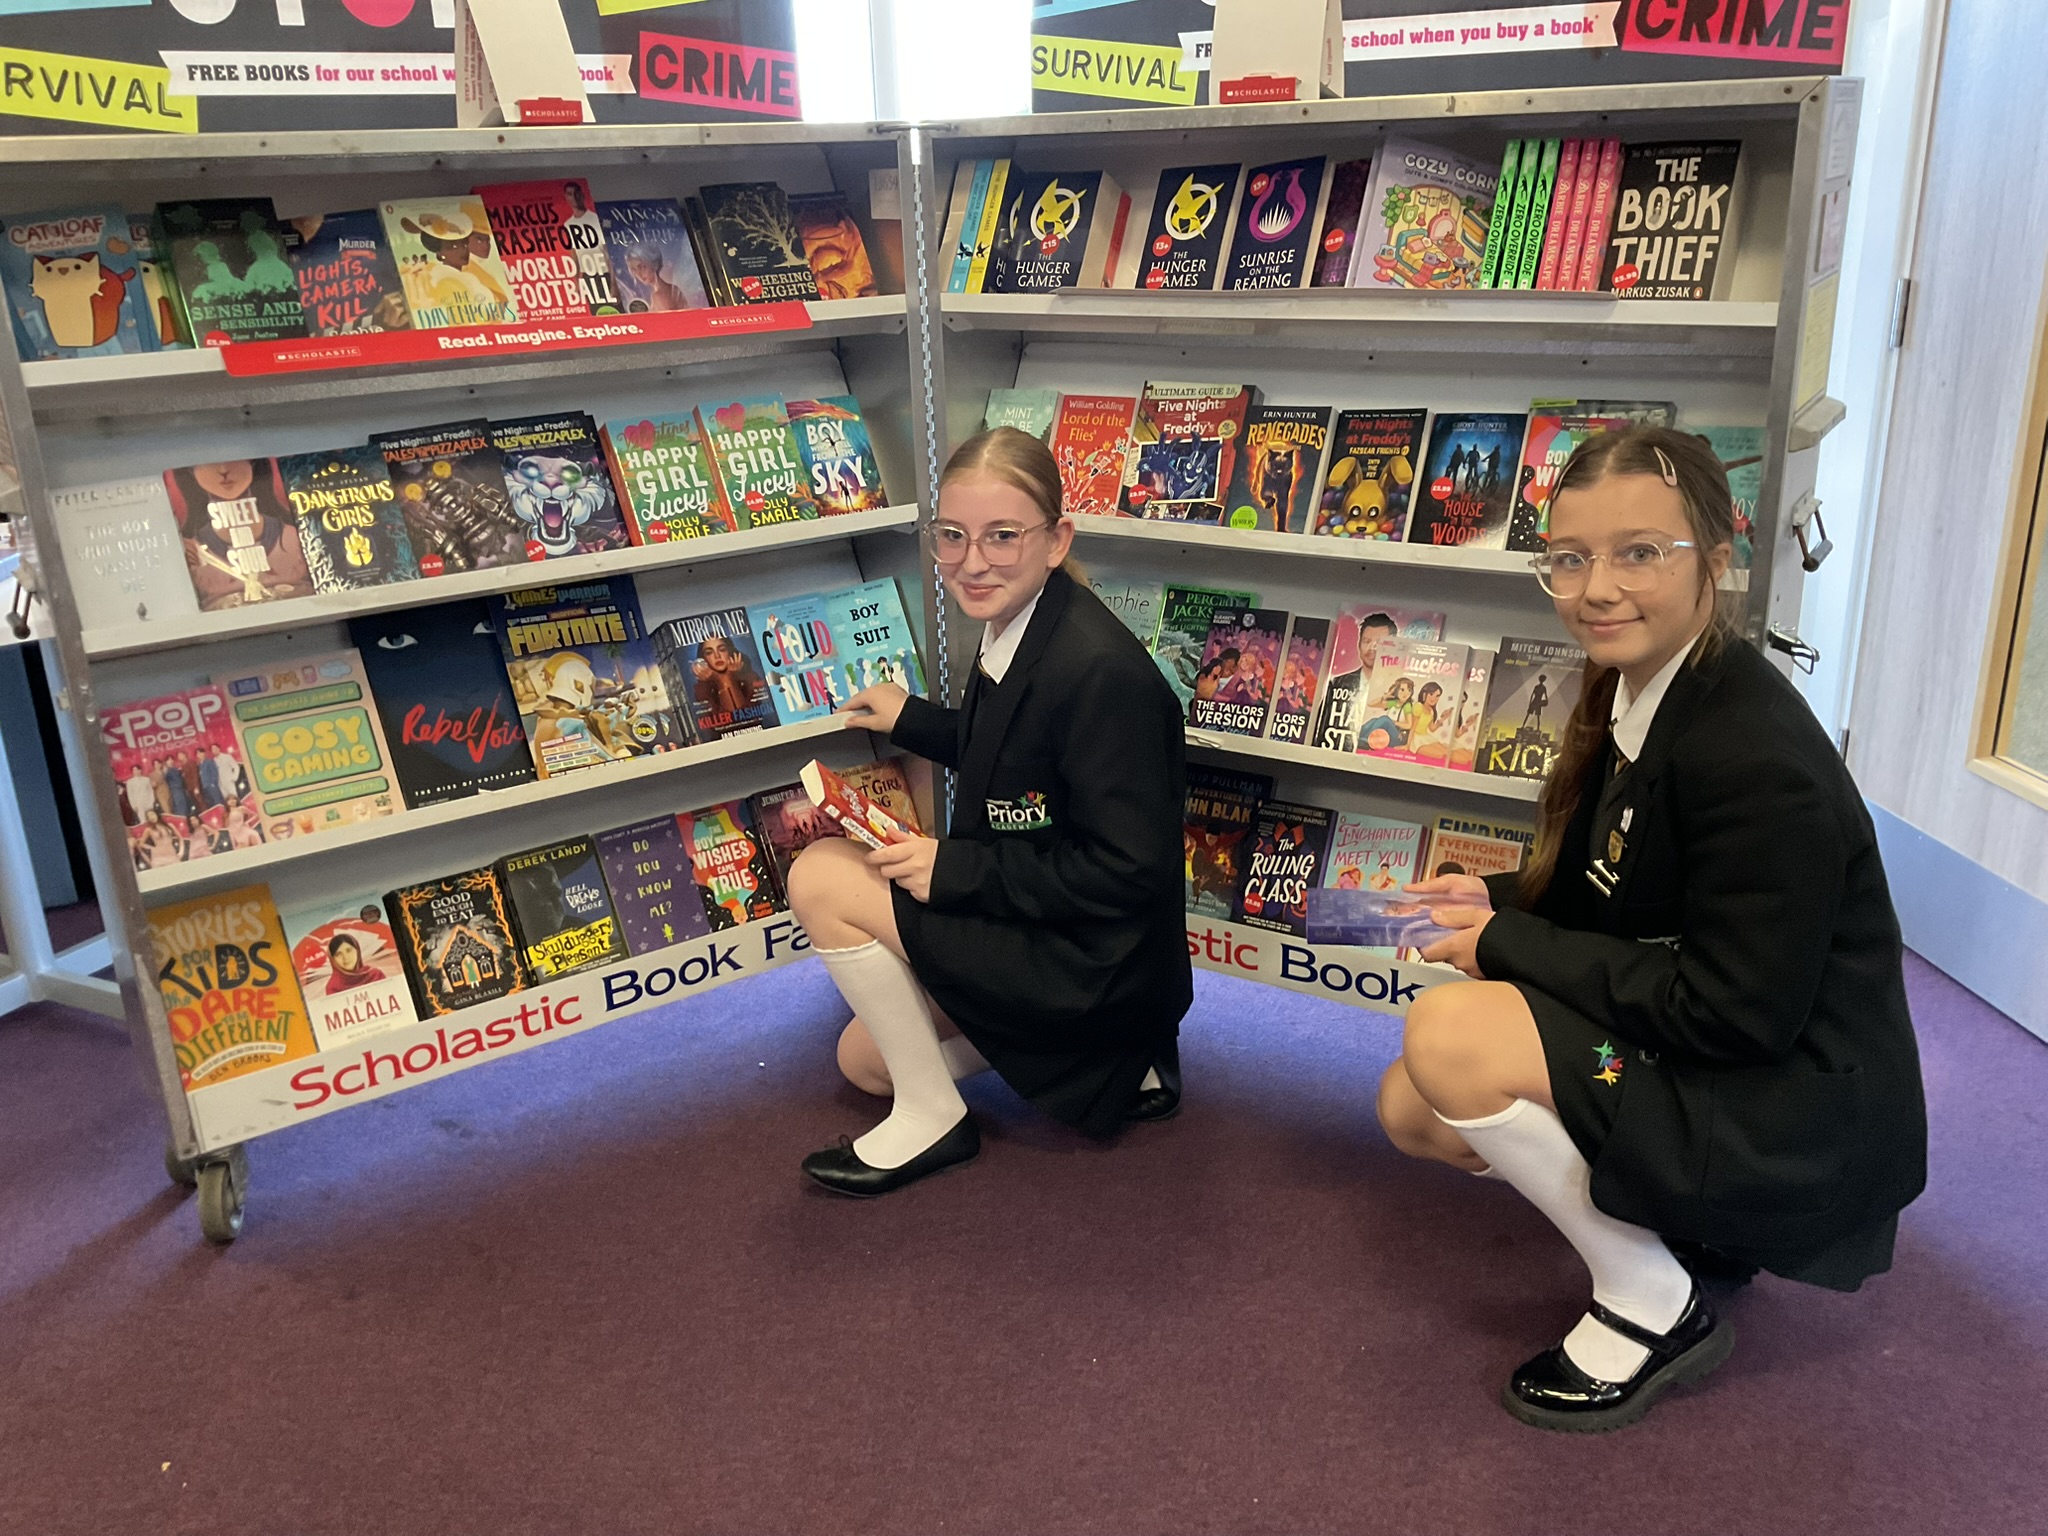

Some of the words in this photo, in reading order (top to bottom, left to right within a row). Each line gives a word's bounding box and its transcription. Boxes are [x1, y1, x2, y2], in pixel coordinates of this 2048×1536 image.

[1350, 28, 1404, 48] school
[1409, 26, 1456, 46] when
[1460, 26, 1491, 46] you
[1496, 22, 1530, 45] buy
[1533, 23, 1546, 37] a
[1636, 0, 1837, 51] CRIME
[186, 64, 240, 82] FREE
[245, 64, 311, 82] BOOKS
[314, 64, 342, 82] for
[346, 67, 376, 82] our
[380, 63, 438, 82] school
[645, 43, 797, 104] CRIME
[1032, 45, 1187, 92] SURVIVAL
[1233, 86, 1291, 97] SCHOLASTIC
[531, 110, 578, 118] SCHOLASTIC
[1404, 153, 1449, 176] COZY
[1655, 157, 1702, 183] THE
[1252, 181, 1267, 192] 13+
[489, 202, 561, 229] MARCUS
[609, 205, 668, 225] WINGS
[1492, 203, 1505, 229] ZERO
[1512, 203, 1527, 228] ZERO
[1532, 203, 1545, 228] ZERO
[1616, 184, 1730, 235] BOOK
[338, 238, 376, 251] MURDER
[494, 223, 600, 257] RASHFORD
[1042, 239, 1057, 250] £15
[1154, 241, 1169, 251] 13+
[1038, 253, 1053, 261] THE
[1173, 251, 1188, 260] THE
[1239, 249, 1296, 268] SUNRISE
[1482, 227, 1501, 277] OVERRIDE
[1503, 227, 1521, 277] OVERRIDE
[1522, 227, 1541, 277] OVERRIDE
[1610, 236, 1721, 283] THIEF
[298, 257, 369, 289] LIGHTS,
[503, 255, 578, 284] WORLD
[581, 252, 607, 276] OF
[1015, 262, 1071, 276] HUNGER
[1150, 259, 1207, 273] HUNGER
[1249, 267, 1262, 276] ON
[1265, 265, 1281, 275] THE
[300, 275, 384, 308] CAMERA,
[1017, 275, 1063, 288] GAMES
[1234, 273, 1292, 291] REAPING
[510, 276, 618, 311] FOOTBALL
[1610, 286, 1653, 300] MARKUS
[1655, 286, 1692, 300] ZUSAK
[191, 303, 256, 321] SENSE
[262, 301, 303, 317] AND
[317, 297, 369, 329] KILL
[530, 307, 565, 317] ULTIMATE
[566, 305, 587, 315] GUIDE
[718, 314, 774, 326] SCHOLASTIC
[219, 315, 305, 331] SENSIBILITY
[438, 333, 494, 349] Read.
[495, 328, 572, 347] Imagine.
[572, 321, 644, 341] Explore.
[288, 348, 359, 359] SCHOLASTIC
[1153, 387, 1194, 398] ULTIMATE
[1196, 387, 1224, 397] GUIDE
[1004, 407, 1034, 420] MINT
[1069, 399, 1095, 410] William
[1095, 400, 1125, 412] Golding
[1157, 399, 1183, 412] Five
[1185, 399, 1227, 413] Nights
[1262, 410, 1281, 419] ERIN
[1283, 410, 1318, 420] HUNTER
[534, 423, 544, 432] at
[1000, 420, 1014, 431] TO
[1017, 420, 1033, 433] BE
[1062, 411, 1091, 426] Lord
[1091, 412, 1105, 426] of
[1106, 415, 1126, 428] the
[1163, 419, 1215, 435] Freddy's
[1183, 411, 1198, 423] at
[1348, 418, 1373, 431] Five
[1375, 418, 1414, 431] Nights
[380, 440, 400, 451] Five
[399, 437, 431, 449] Nights
[432, 433, 442, 443] at
[716, 427, 787, 450] HAPPY
[805, 420, 845, 446] BOY
[1246, 421, 1326, 450] RENEGADES
[1345, 434, 1358, 445] at
[1361, 433, 1411, 446] Freddy's
[383, 449, 415, 463] TALES
[624, 445, 698, 469] HAPPY
[726, 445, 797, 476] GIRL
[1349, 447, 1376, 455] FAZBEAR
[1376, 446, 1401, 455] FRIGHTS
[634, 463, 709, 496] GIRL
[810, 455, 868, 495] SKY
[732, 469, 800, 503] Lucky
[288, 479, 396, 515] DANGEROUS
[640, 489, 710, 522] Lucky
[321, 504, 379, 533] GIRLS
[750, 505, 800, 526] SMALE
[1443, 499, 1486, 518] HOUSE
[664, 515, 700, 531] HOLLY
[1430, 522, 1488, 545] WOODS
[557, 583, 611, 601] WARRIOR
[849, 602, 880, 622] BOY
[506, 612, 628, 657] FORTNITE
[669, 612, 724, 648] MIRROR
[728, 608, 750, 637] ME
[853, 625, 891, 647] SUIT
[762, 619, 833, 668] CLOUD
[1510, 642, 1541, 655] MITCH
[1543, 645, 1587, 659] JOHNSON
[1380, 655, 1400, 668] The
[1403, 656, 1460, 677] Luckies
[780, 664, 845, 712] NINE
[698, 711, 733, 730] KILLER
[732, 703, 776, 722] FASHION
[1196, 700, 1216, 712] THE
[1217, 702, 1265, 718] TAYLORS
[401, 703, 478, 745] Rebel
[1196, 710, 1262, 731] VERSION
[137, 725, 197, 749] IDOLS
[254, 714, 362, 761] COSY
[262, 743, 372, 784] GAMING
[1488, 742, 1562, 776] KICK
[871, 778, 903, 796] GIRL
[1211, 775, 1263, 793] PULLMAN
[986, 803, 1046, 823] Priory
[1302, 816, 1328, 826] BARNES
[709, 824, 722, 834] THE
[1337, 821, 1417, 848] ENCHANTED
[1439, 817, 1491, 837] FIND
[1493, 826, 1536, 846] YOUR
[632, 838, 650, 854] DO
[693, 836, 714, 852] BOY
[1278, 838, 1295, 851] The
[1438, 836, 1519, 860] EVERYONE'S
[507, 854, 548, 872] DEREK
[550, 843, 588, 861] LANDY
[692, 840, 751, 871] WISHES
[1249, 851, 1316, 880] RULING
[1333, 849, 1373, 867] MEET
[1377, 850, 1410, 868] YOU
[1443, 850, 1507, 871] THINKING
[634, 859, 661, 876] YOU
[716, 863, 737, 875] CAME
[564, 883, 588, 896] HELL
[637, 878, 672, 899] KNOW
[710, 867, 754, 896] TRUE
[1244, 877, 1307, 905] CLASS
[430, 890, 471, 909] GOOD
[432, 901, 475, 917] ENOUGH
[566, 888, 600, 909] BREAKS
[576, 899, 604, 914] LOOSE
[436, 916, 448, 925] TO
[449, 908, 475, 924] EAT
[649, 901, 673, 918] ME?
[146, 901, 266, 963] STORIES
[533, 919, 615, 961] Skulduggery
[552, 941, 610, 973] Pleasant
[159, 940, 279, 1000] KIDS
[1280, 942, 1426, 1005] Book
[167, 985, 281, 1043] DARE
[324, 993, 401, 1032] MALALA
[289, 994, 583, 1111] Scholastic
[602, 942, 744, 1013] Book
[174, 1009, 296, 1070] DIFFERENT
[232, 1053, 272, 1070] BROOKS
